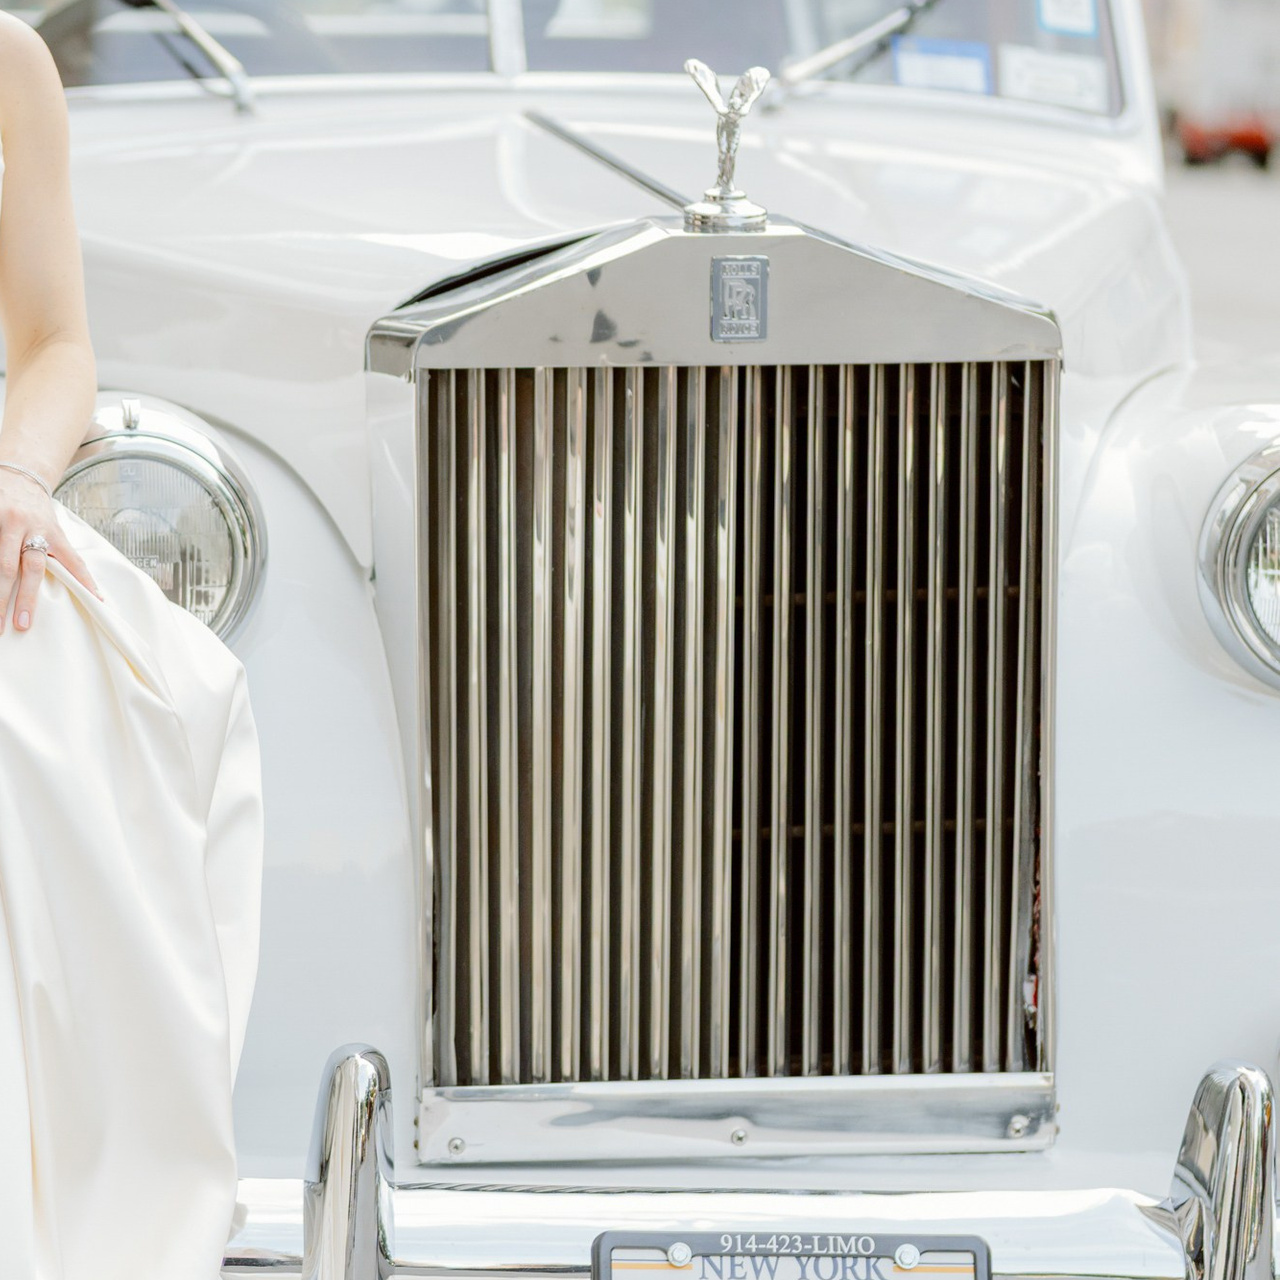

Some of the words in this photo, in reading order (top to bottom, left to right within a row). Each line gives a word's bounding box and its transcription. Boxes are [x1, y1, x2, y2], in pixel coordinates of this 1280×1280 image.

[722, 264, 758, 276] ROLLS
[720, 1234, 876, 1255] 914-423-LIMO
[698, 1255, 780, 1280] NEW
